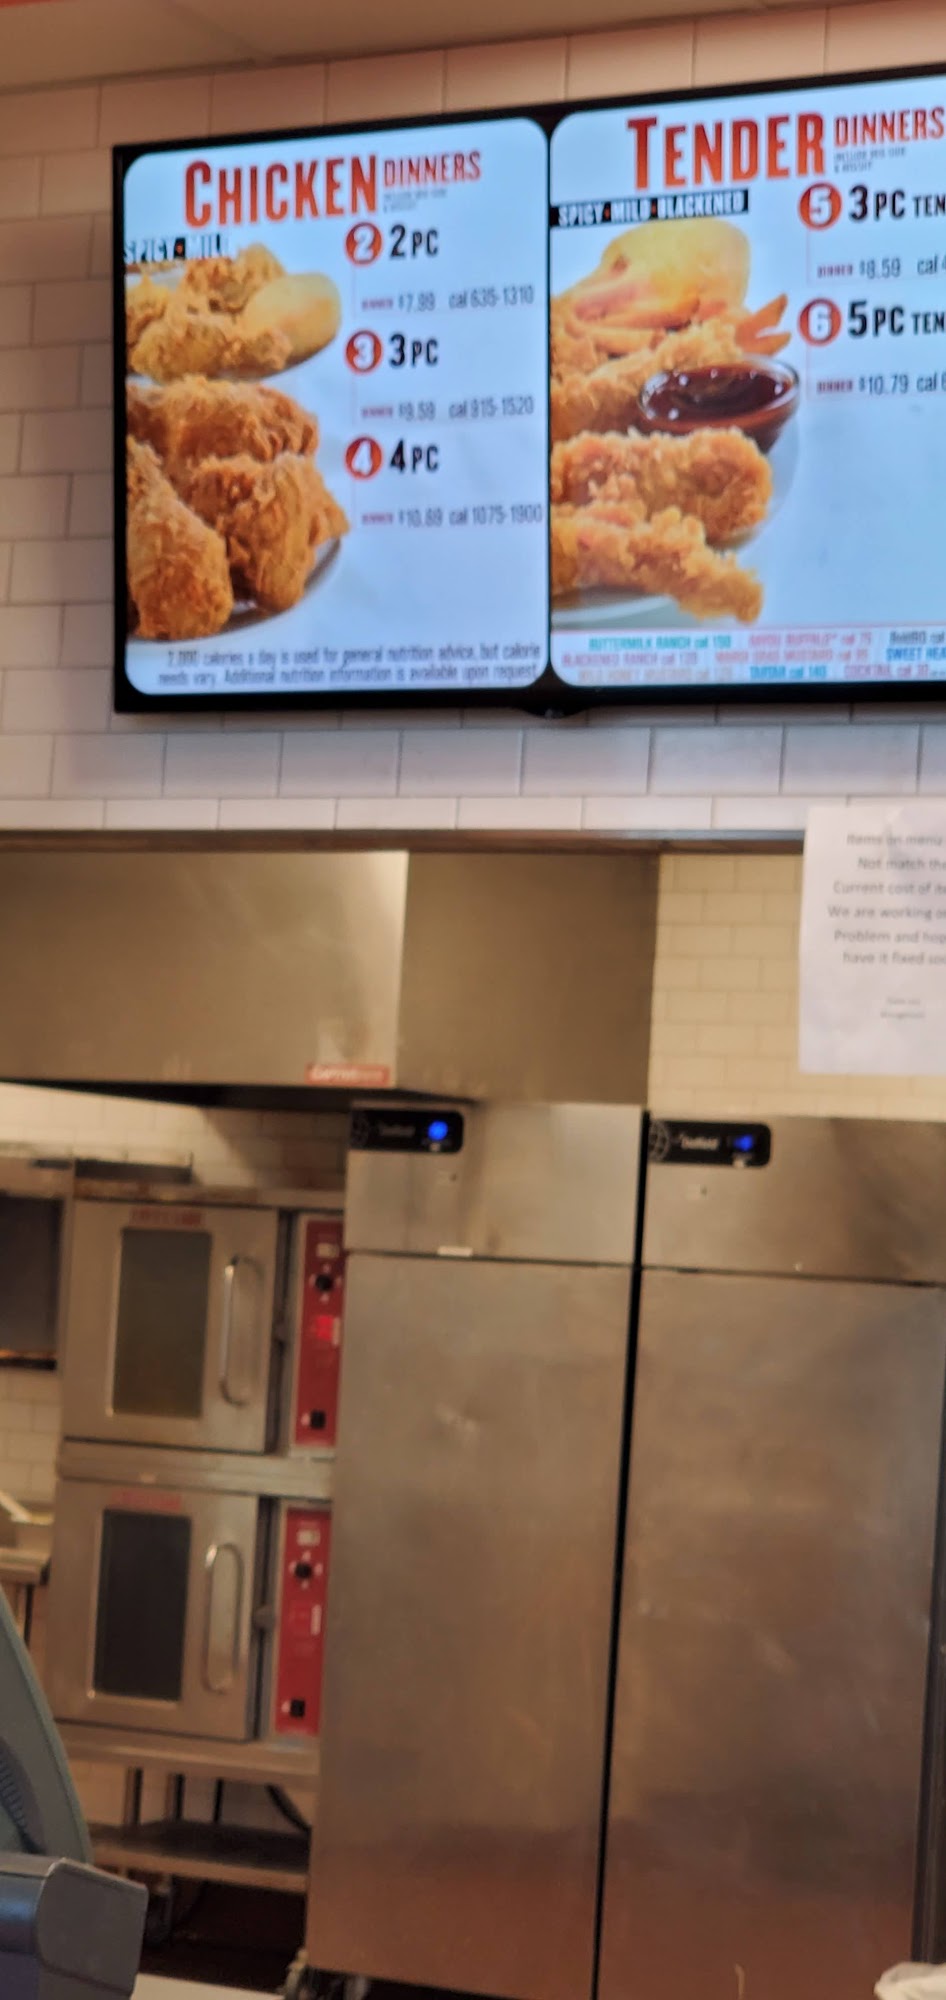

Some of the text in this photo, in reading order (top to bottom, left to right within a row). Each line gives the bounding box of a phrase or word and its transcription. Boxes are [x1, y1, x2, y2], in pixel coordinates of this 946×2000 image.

[627, 106, 945, 190] TENDER DINNERS
[184, 151, 481, 229] CHICKEN DINNERS
[917, 254, 938, 275] cal
[449, 290, 467, 309] cal
[917, 371, 937, 393] cal
[449, 399, 467, 418] cal
[449, 507, 467, 526] cal
[833, 880, 884, 894] Current
[834, 929, 890, 942] Problem
